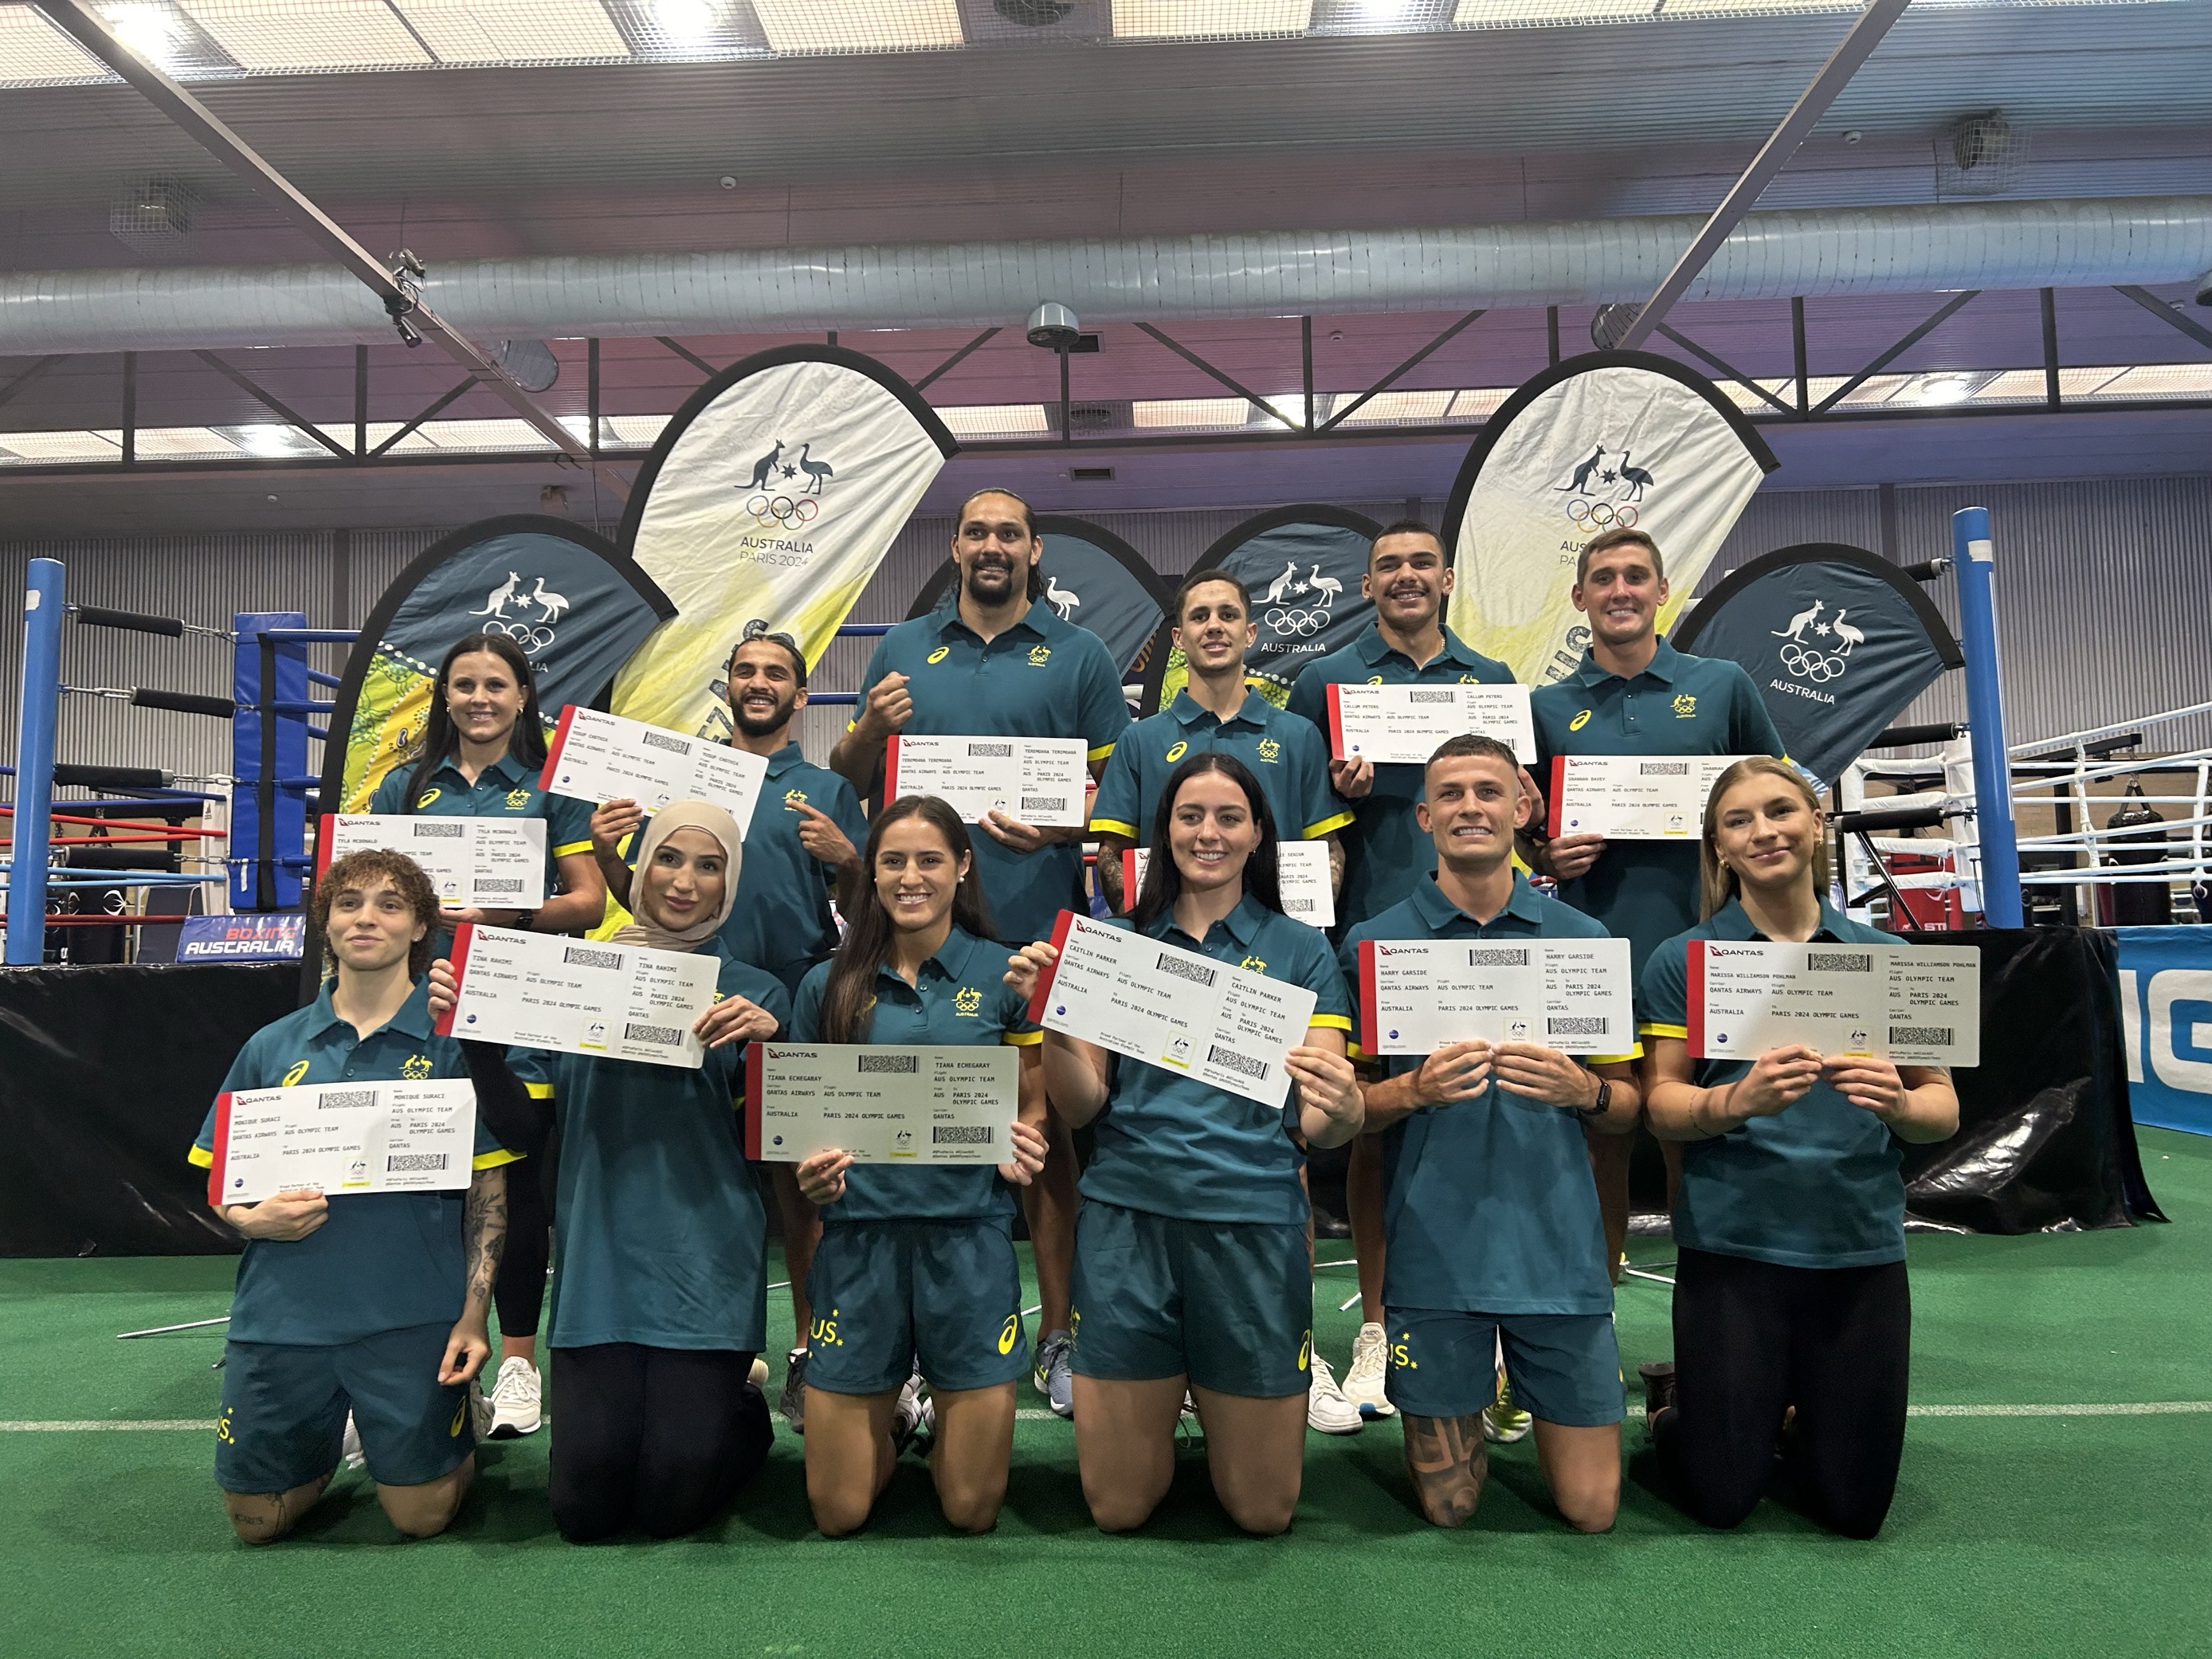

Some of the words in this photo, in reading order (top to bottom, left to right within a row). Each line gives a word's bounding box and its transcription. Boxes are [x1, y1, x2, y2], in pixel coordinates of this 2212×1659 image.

[740, 536, 814, 554] AUSTRALIA
[739, 551, 777, 565] PARIS
[779, 555, 808, 567] 2024
[1261, 642, 1326, 653] AUSTRALIA
[1770, 678, 1835, 705] AUSTRALIA
[226, 927, 296, 940] BOXING
[487, 935, 527, 944] QANTAS
[1084, 926, 1123, 943] QANTAS
[185, 940, 295, 955] AUSTRALIA
[1069, 944, 1094, 957] CAITLIN
[1095, 952, 1118, 964] PARKER
[1063, 959, 1084, 971] QANTAS
[1085, 966, 1111, 979] AIRWAYS
[649, 977, 675, 986] OLYMPIC
[1057, 979, 1088, 994] AUSTRALIA
[1116, 977, 1128, 986] AUS
[1130, 981, 1155, 994] OLYMPIC
[1156, 990, 1172, 999] TEAM
[1230, 982, 1257, 995] CAITLIN
[1259, 990, 1283, 1003] PARKER
[1110, 997, 1128, 1008] PARIS
[1130, 1004, 1145, 1014] 2024
[1146, 1009, 1169, 1022] OLYMPIC
[1169, 1017, 1189, 1028] GAMES
[1220, 1011, 1233, 1020] AUS
[1225, 996, 1237, 1006] AUS
[1239, 1001, 1267, 1014] OLYMPIC
[1269, 1010, 1286, 1020] TEAM
[1238, 1018, 1258, 1029] PARIS
[1260, 1024, 1275, 1033] 2024
[1214, 1032, 1236, 1044] QANTAS
[1236, 1025, 1262, 1037] OLYMPIC
[1264, 1033, 1284, 1044] GAMES
